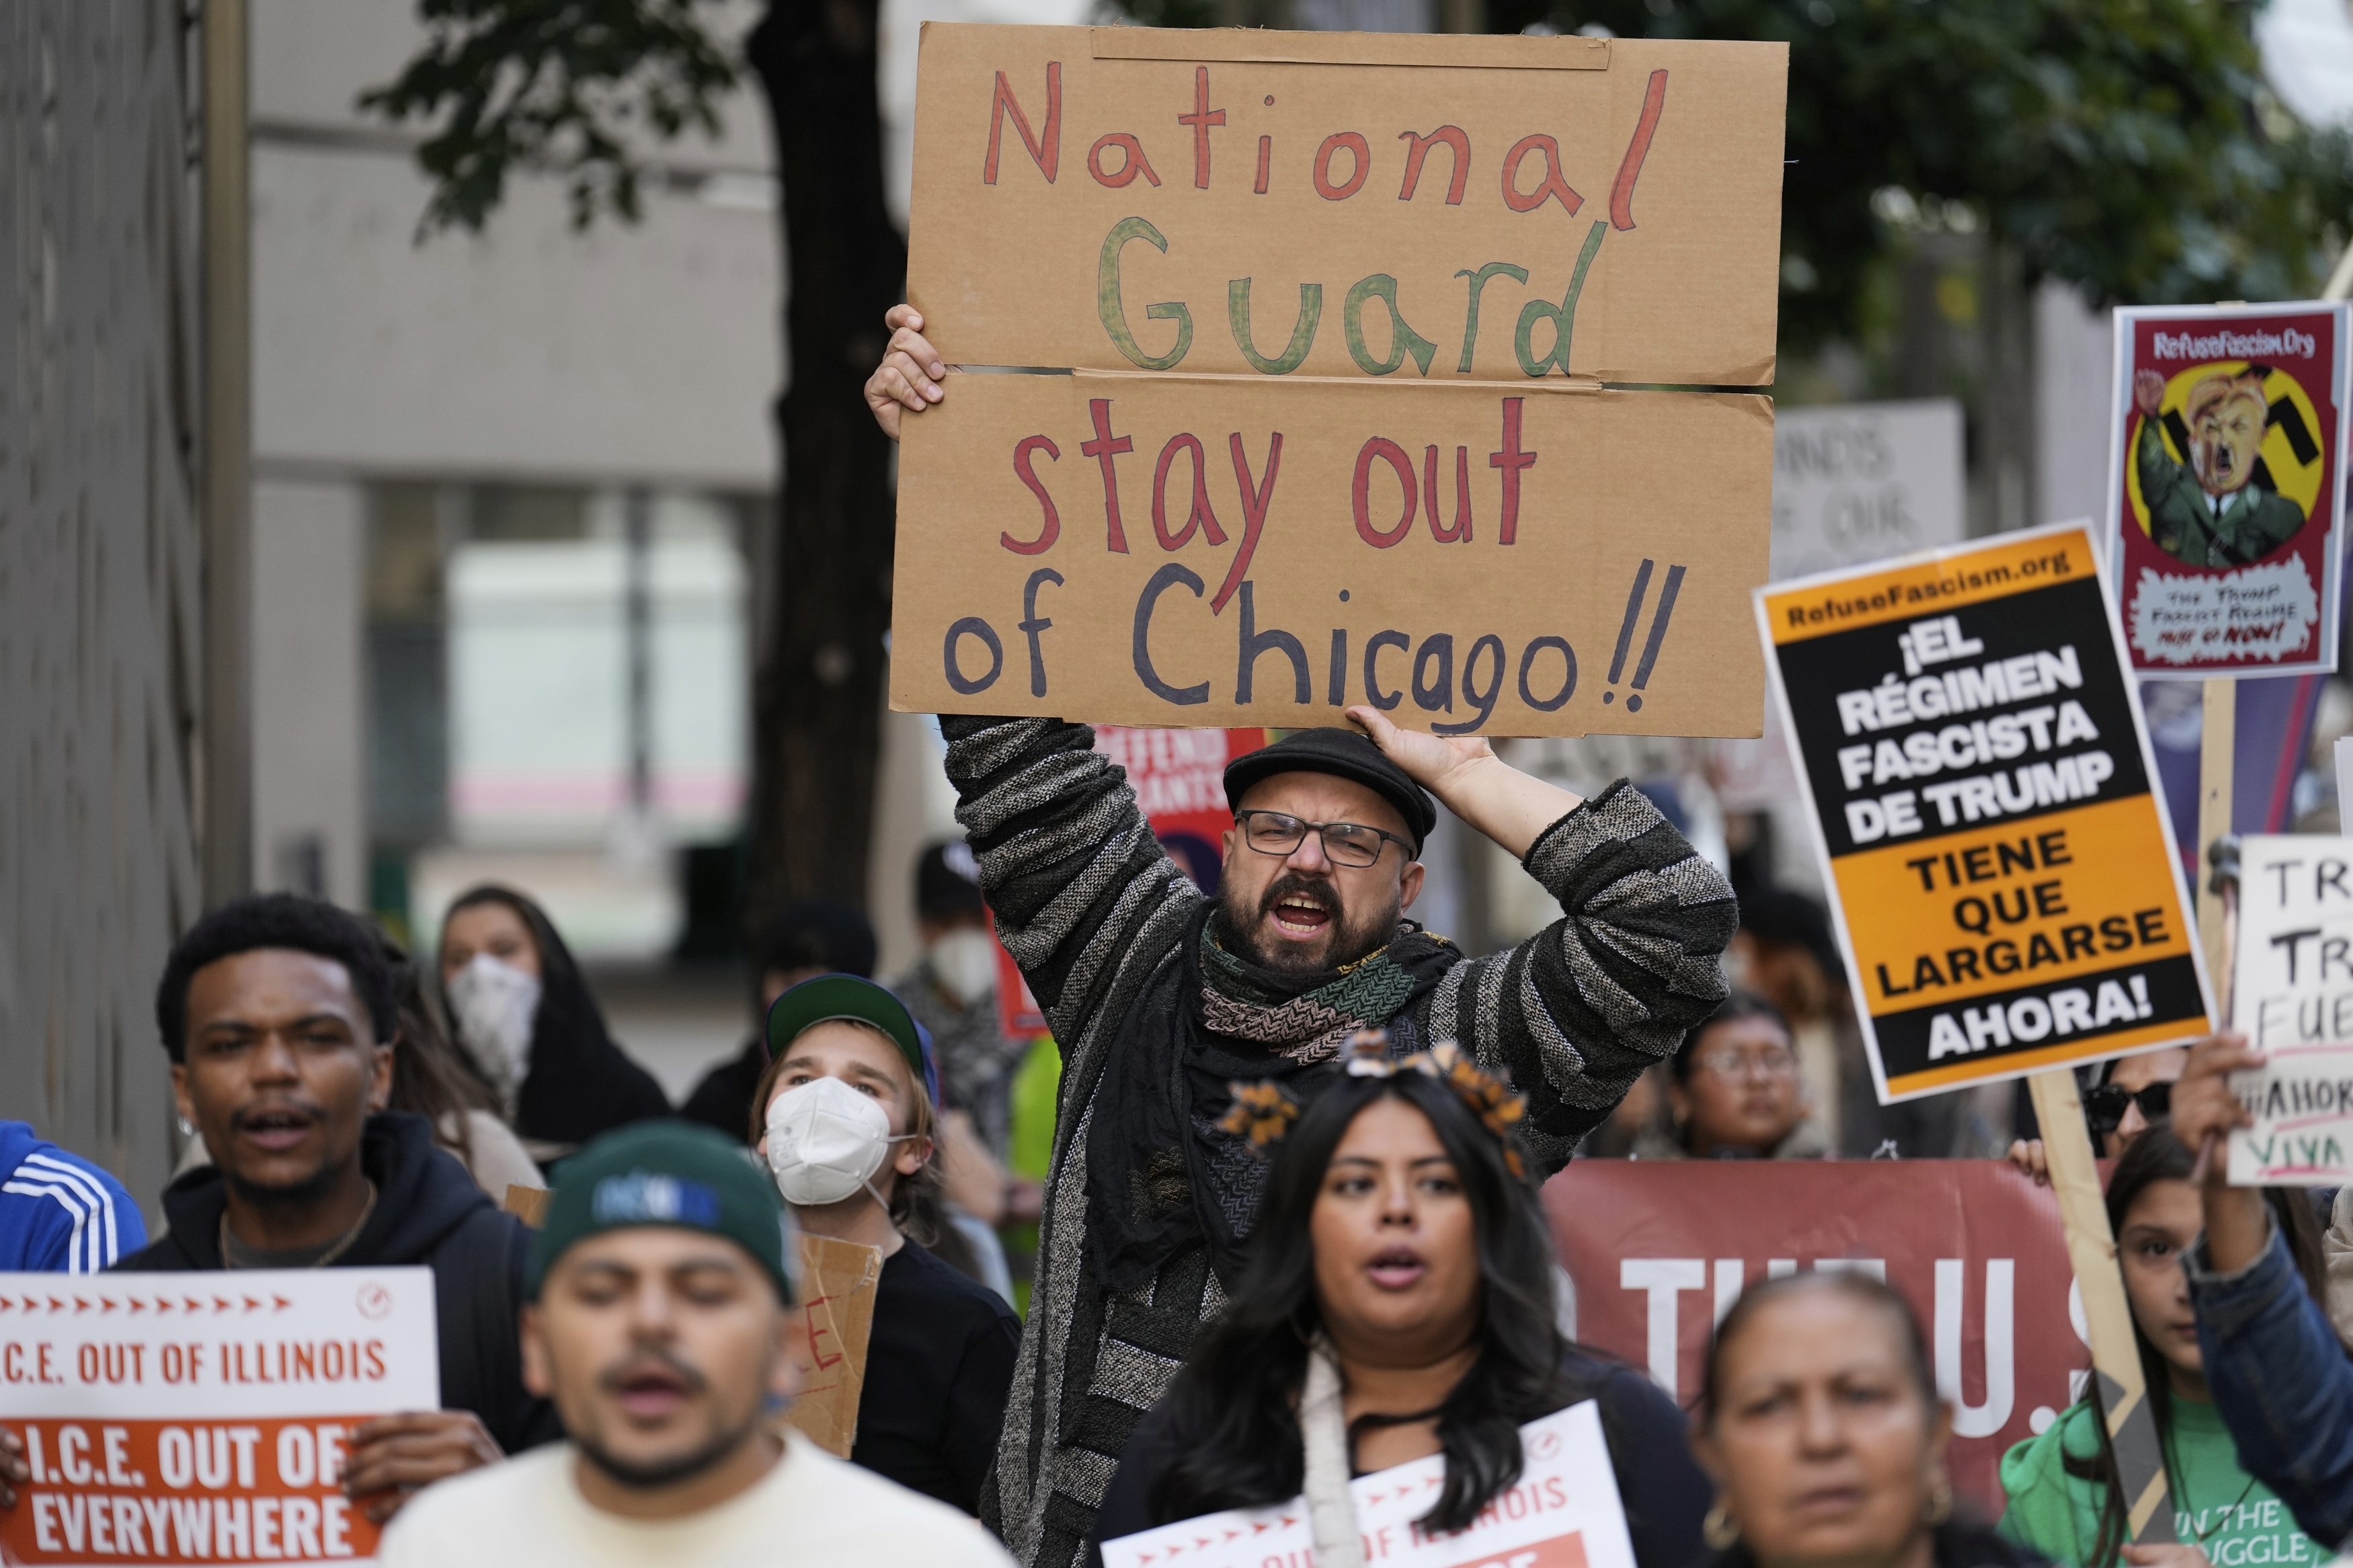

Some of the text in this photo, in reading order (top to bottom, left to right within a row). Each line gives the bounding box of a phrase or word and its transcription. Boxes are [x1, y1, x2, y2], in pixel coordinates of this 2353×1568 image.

[984, 61, 1668, 231] National
[1098, 216, 1609, 379] Guard
[2153, 327, 2317, 360] RefuseFascism.Org
[1000, 397, 1538, 616] stay out
[1787, 548, 2072, 629] RefuseFascism.org
[2217, 583, 2280, 604] TRUMP
[2228, 602, 2297, 622] REGIME
[943, 559, 1687, 735] of Chicago!!
[1897, 614, 1984, 676] ¡EL
[1836, 644, 2083, 736] RÉGIMEN
[1837, 700, 2100, 790] FASCISTA
[1844, 750, 2115, 845] DE TRUMP
[1907, 829, 2073, 892] TIENE
[1953, 880, 2069, 937] QUE
[1876, 907, 2171, 998] LARGARSE
[1927, 975, 2153, 1061] AHORA!
[77, 1342, 146, 1385] OUT
[161, 1342, 203, 1385] OF
[220, 1339, 387, 1384] ILLINOIS
[26, 1423, 348, 1489] I.C.E. OUT OF
[31, 1493, 355, 1559] EVERYWHERE
[2216, 1499, 2282, 1532] THE
